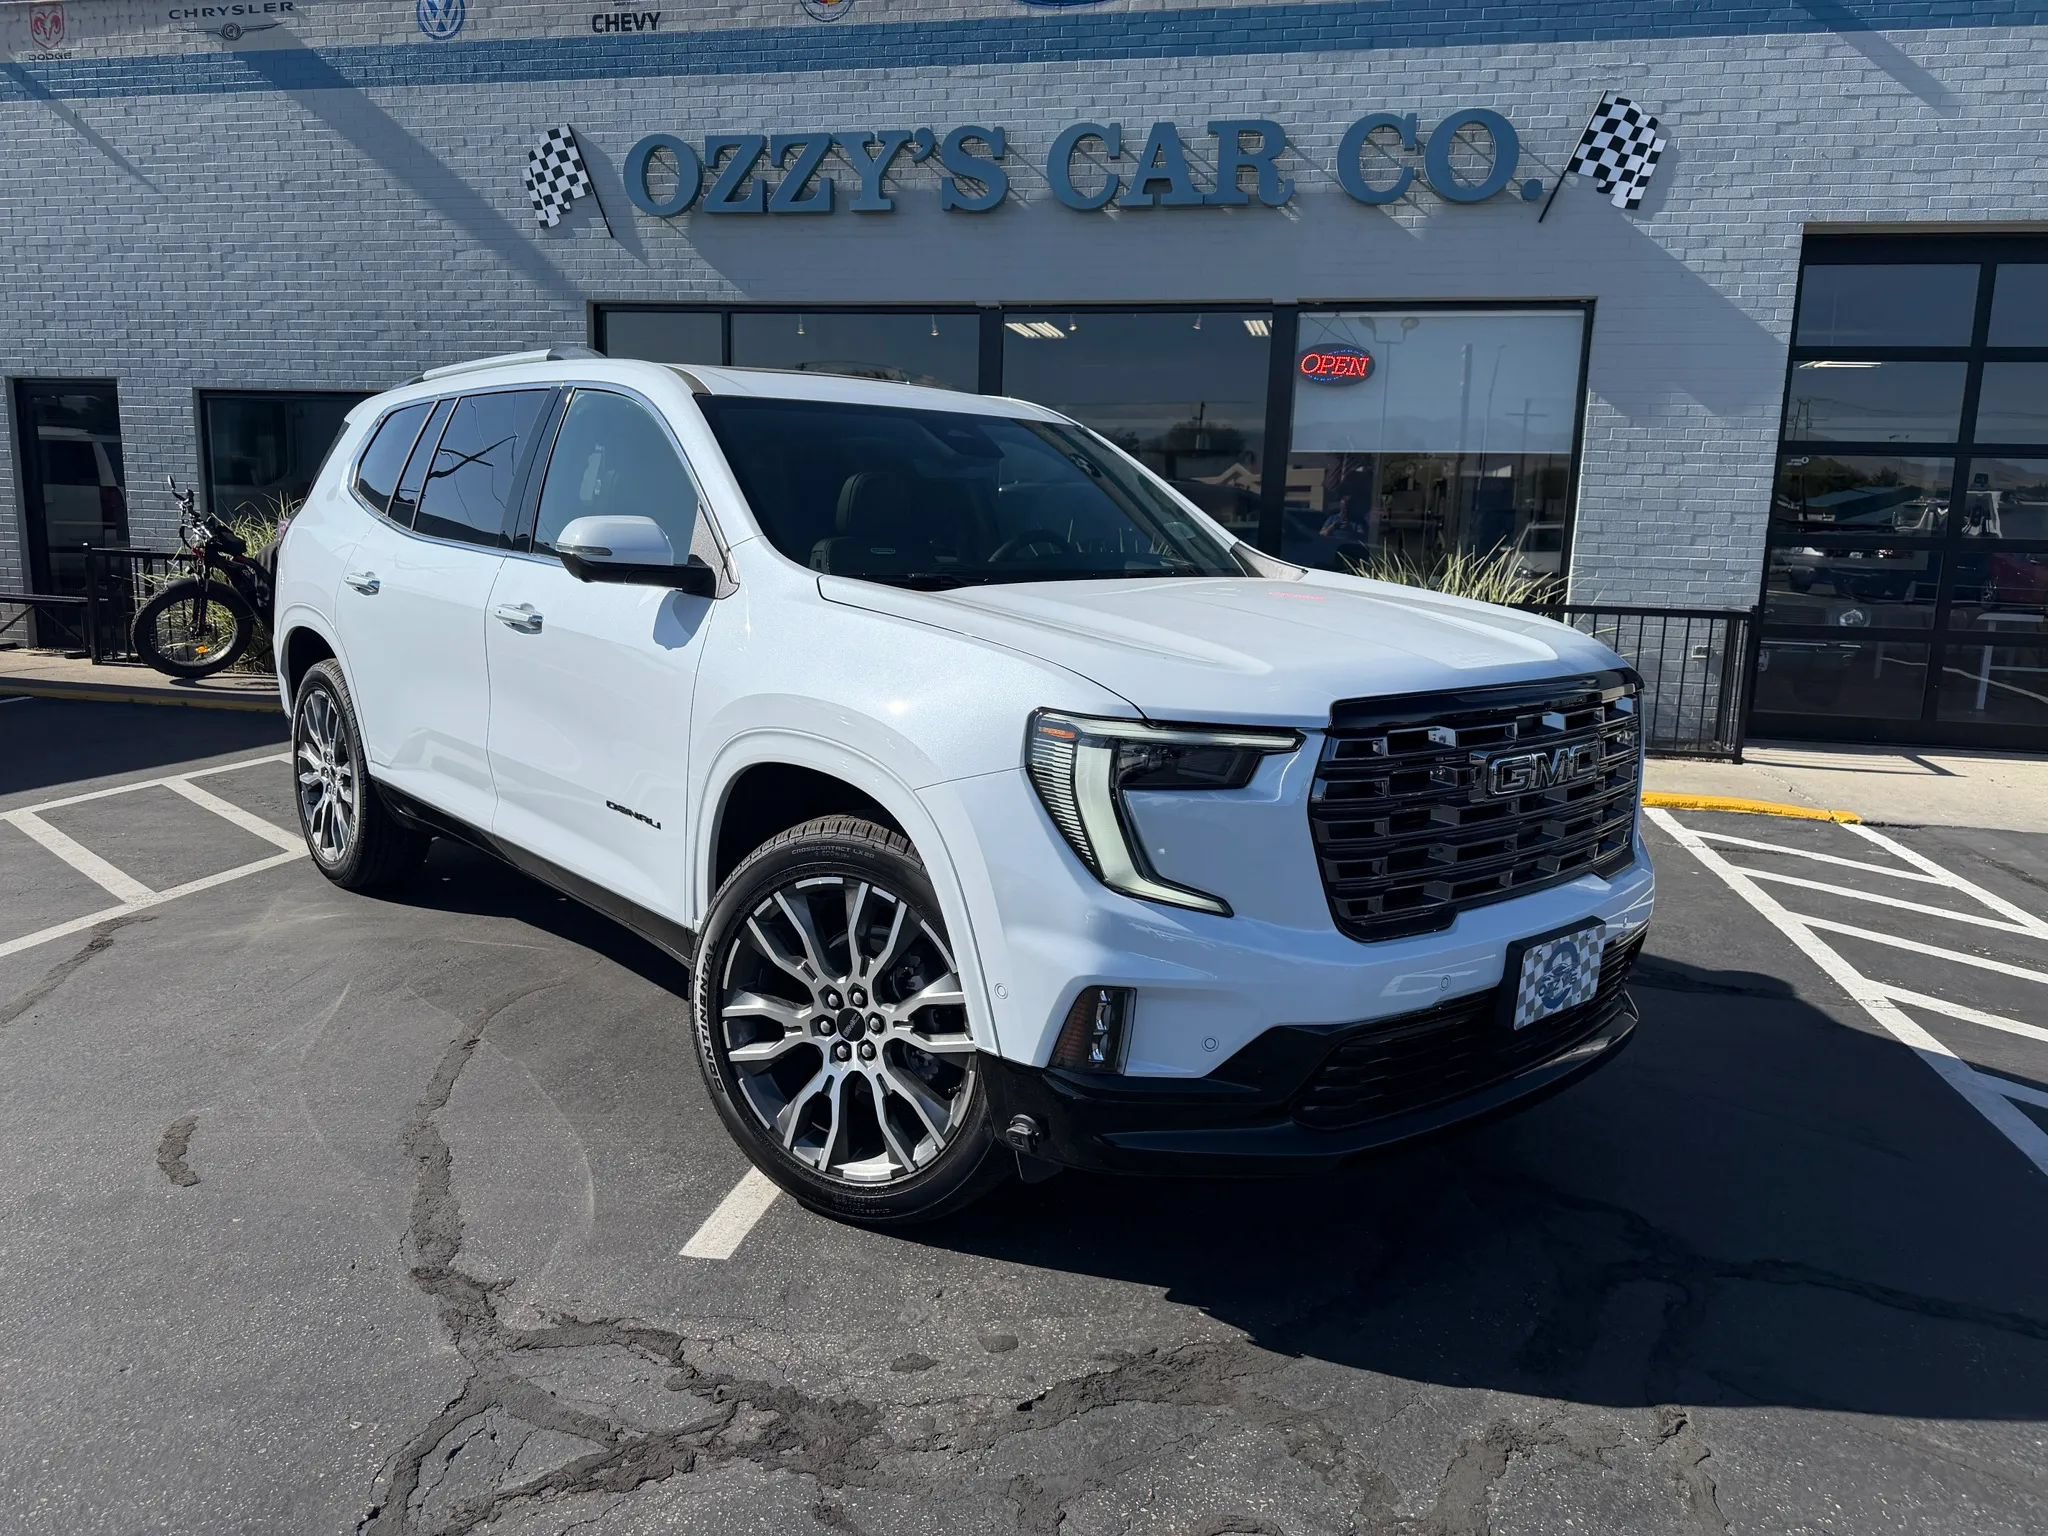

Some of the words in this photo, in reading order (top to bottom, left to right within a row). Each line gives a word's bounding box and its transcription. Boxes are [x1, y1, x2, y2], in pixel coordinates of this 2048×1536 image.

[168, 2, 294, 19] CHRYSLER
[592, 12, 660, 33] CHEVY
[28, 52, 72, 61] DODGE
[623, 125, 1009, 217] OZZY'S
[1046, 119, 1295, 212] CAR
[1336, 108, 1543, 205] CO.
[1300, 353, 1369, 376] OPEN
[1488, 741, 1599, 795] GMC
[700, 939, 725, 1093] CONTINENTAL
